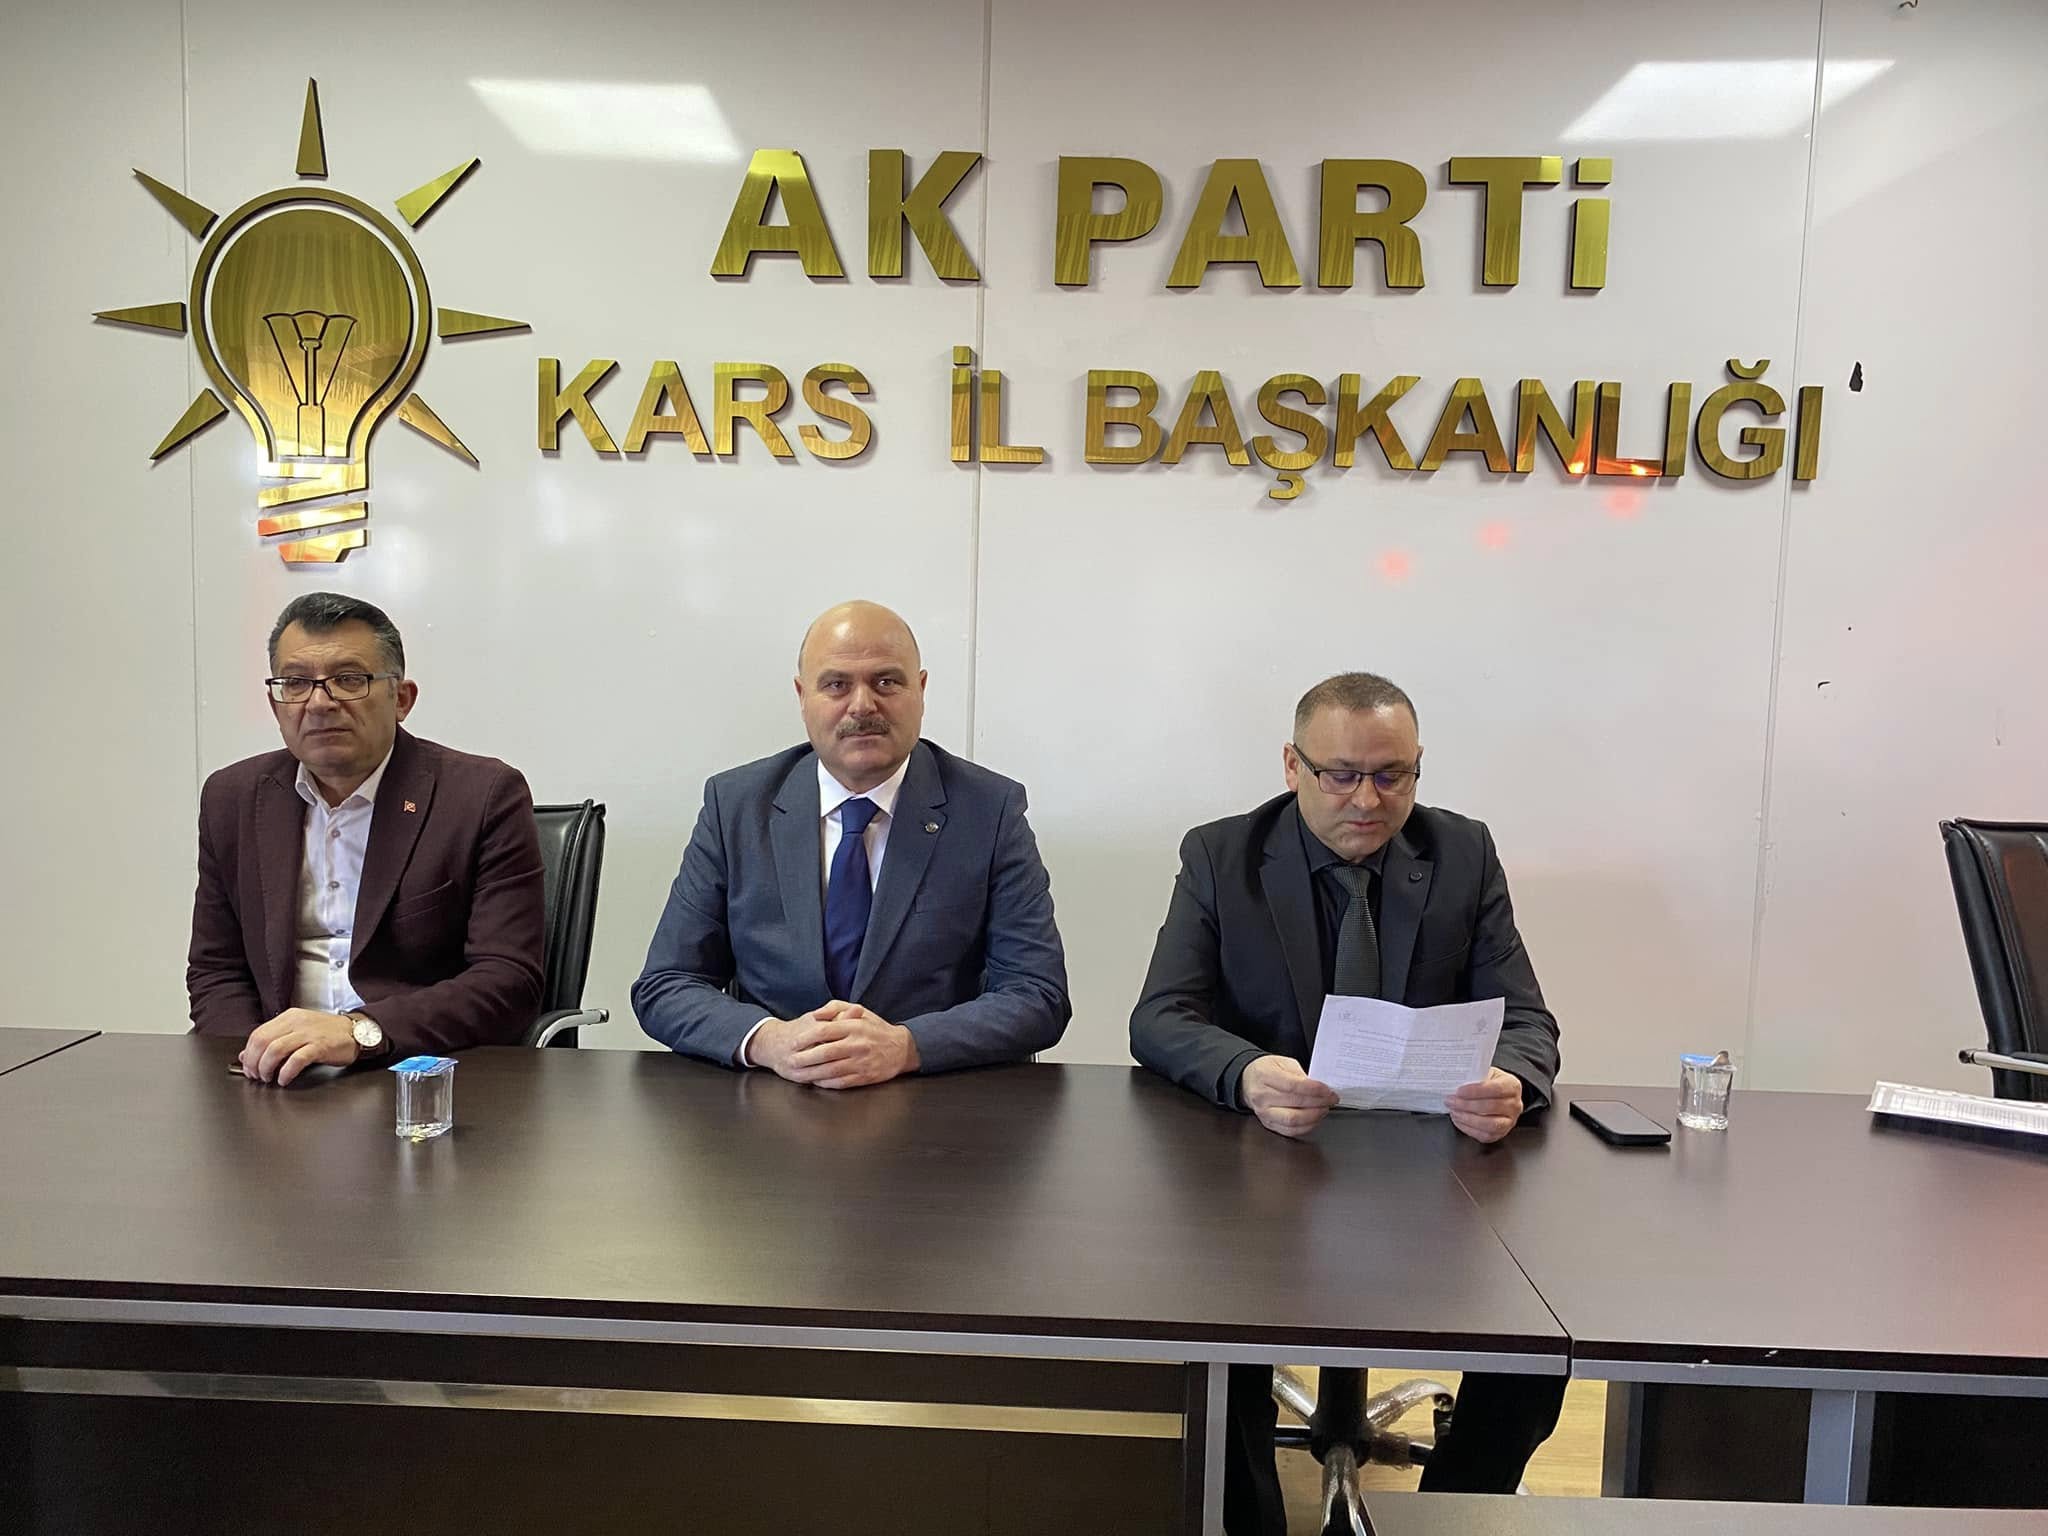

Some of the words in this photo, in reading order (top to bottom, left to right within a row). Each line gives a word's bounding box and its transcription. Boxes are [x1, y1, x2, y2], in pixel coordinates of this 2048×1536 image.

[710, 148, 982, 281] AK
[537, 357, 875, 462] KARS
[950, 345, 1046, 465] İL
[1085, 359, 1824, 499] BAŞKANLIĞI
